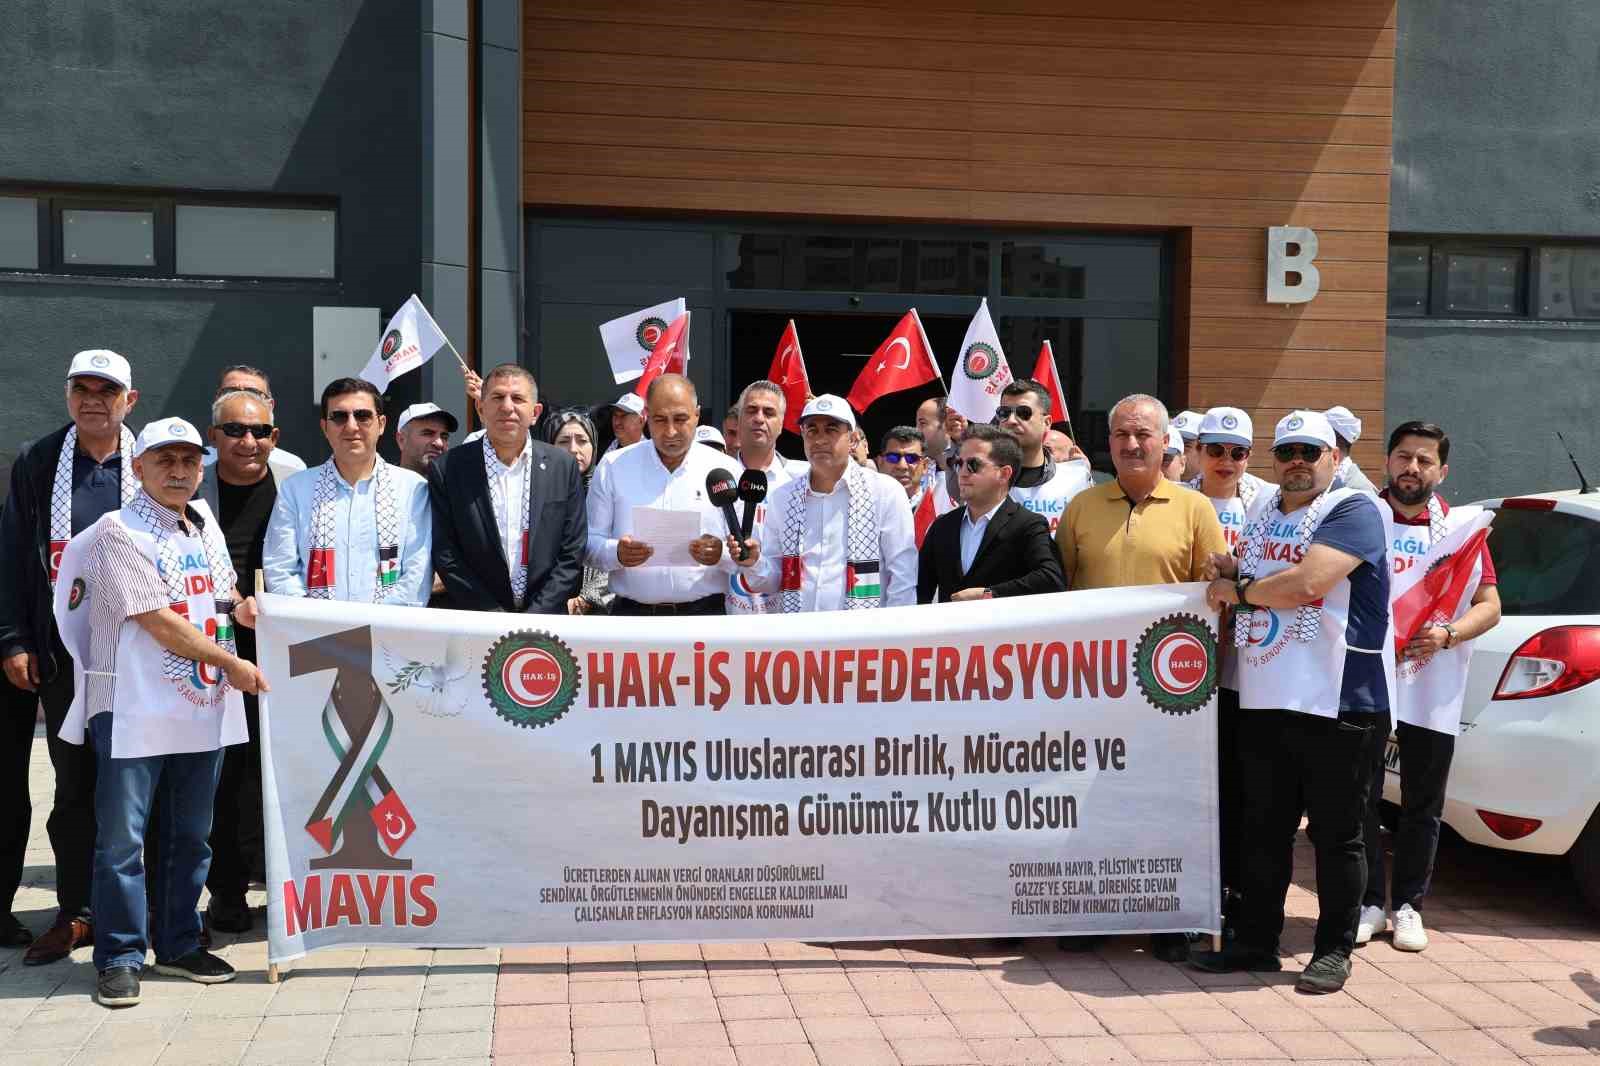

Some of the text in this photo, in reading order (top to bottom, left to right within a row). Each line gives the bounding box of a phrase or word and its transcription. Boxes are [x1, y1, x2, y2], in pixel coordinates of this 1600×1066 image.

[1265, 226, 1319, 304] B
[587, 639, 1128, 711] HAK-İŞ KONFEDERASYONU
[590, 730, 1126, 783] 1 MAYIS Uluslararası Birlik, Mücadele ve
[641, 787, 1078, 844] Dayanışma Günümüz Kutlu Olsun
[563, 866, 631, 883] ÜCRETLERDEN
[634, 868, 671, 883] ALINAN
[673, 866, 702, 883] VERGİ
[704, 867, 753, 882] ORANLARI
[1009, 862, 1062, 878] SOYKIRIMA
[1065, 860, 1096, 877] HAYIR,
[1148, 857, 1183, 873] DESTEK
[540, 884, 848, 902] SENDİKAL ÖRGÜTLENMENİN ÖNÜNDEKİ ENGELLER KALDIRILMALI
[1062, 880, 1096, 896] SELAM,
[1144, 877, 1177, 893] DEVAM
[284, 873, 438, 937] MAYIS
[637, 904, 693, 920] ENFLASYON
[756, 904, 814, 919] KORUNMALI
[1011, 898, 1050, 915] FİLİSTİN
[1053, 897, 1081, 914] BİZİM
[1083, 897, 1120, 914] KIRMIZI
